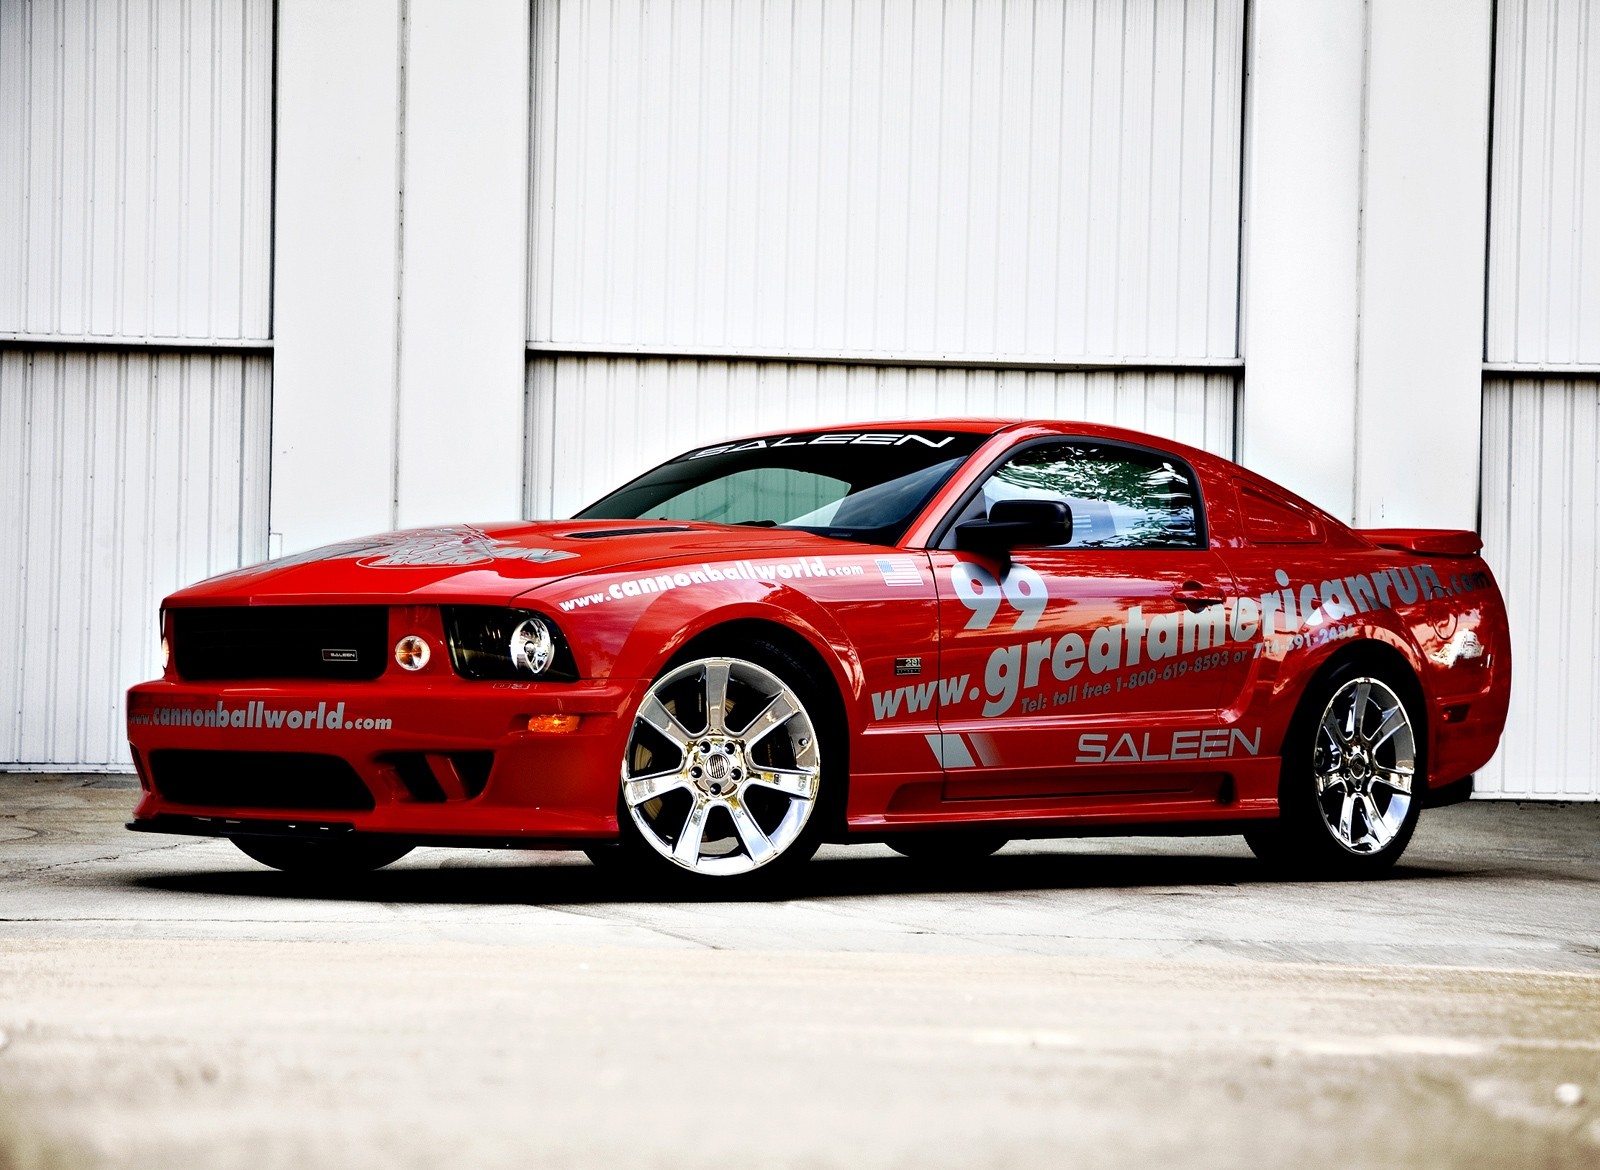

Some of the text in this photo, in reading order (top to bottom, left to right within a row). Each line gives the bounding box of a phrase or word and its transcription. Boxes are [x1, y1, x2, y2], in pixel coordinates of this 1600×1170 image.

[689, 434, 955, 460] SALEEN
[558, 557, 864, 612] www.cannonballworld.com
[951, 562, 1048, 630] 99
[871, 563, 1492, 721] www.greatamericanrun.com
[1021, 694, 1048, 714] Tel:
[1053, 684, 1077, 707] toll
[1082, 678, 1112, 700] free
[1116, 650, 1229, 693] 1-800-619-8593
[1233, 650, 1248, 663] or
[1075, 727, 1262, 763] SALEEN
